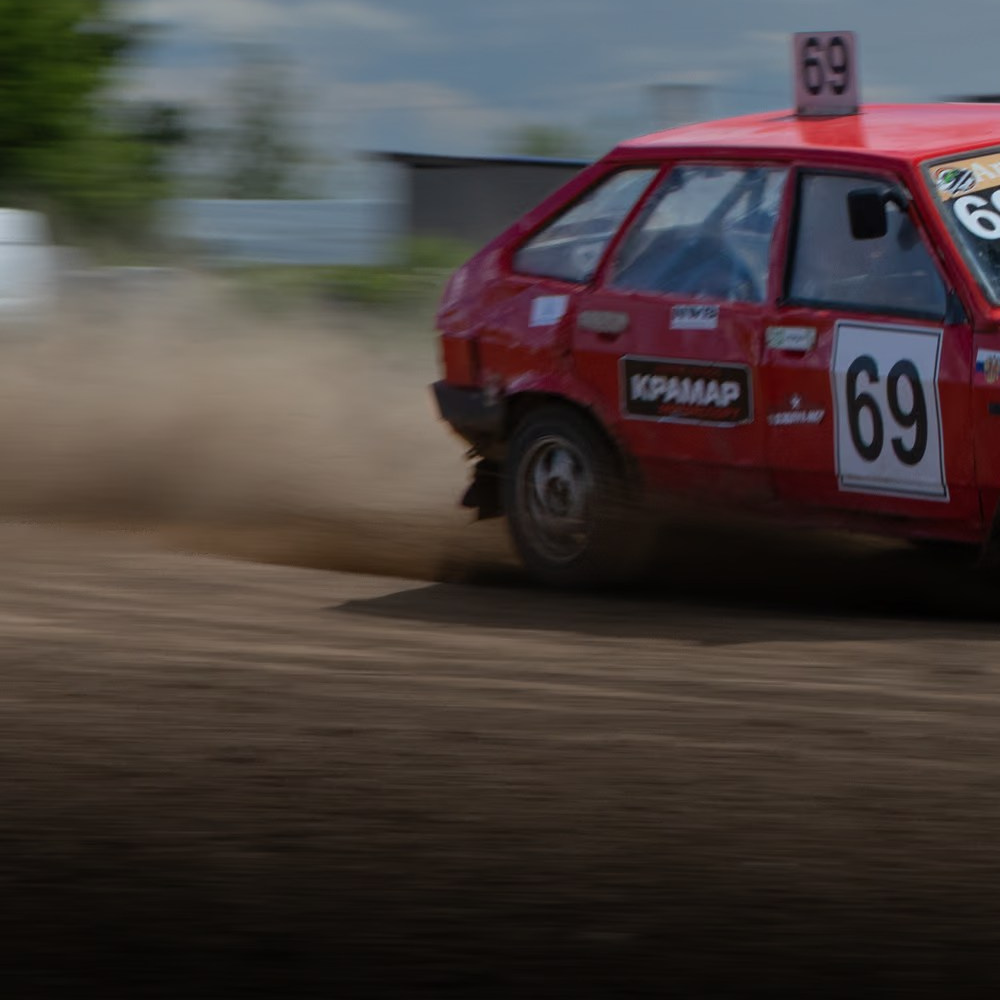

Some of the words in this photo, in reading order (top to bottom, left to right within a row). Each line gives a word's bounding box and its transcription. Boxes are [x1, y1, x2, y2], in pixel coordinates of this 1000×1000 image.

[802, 36, 849, 96] 69
[630, 373, 741, 408] КРАМАР
[846, 354, 928, 467] 69
